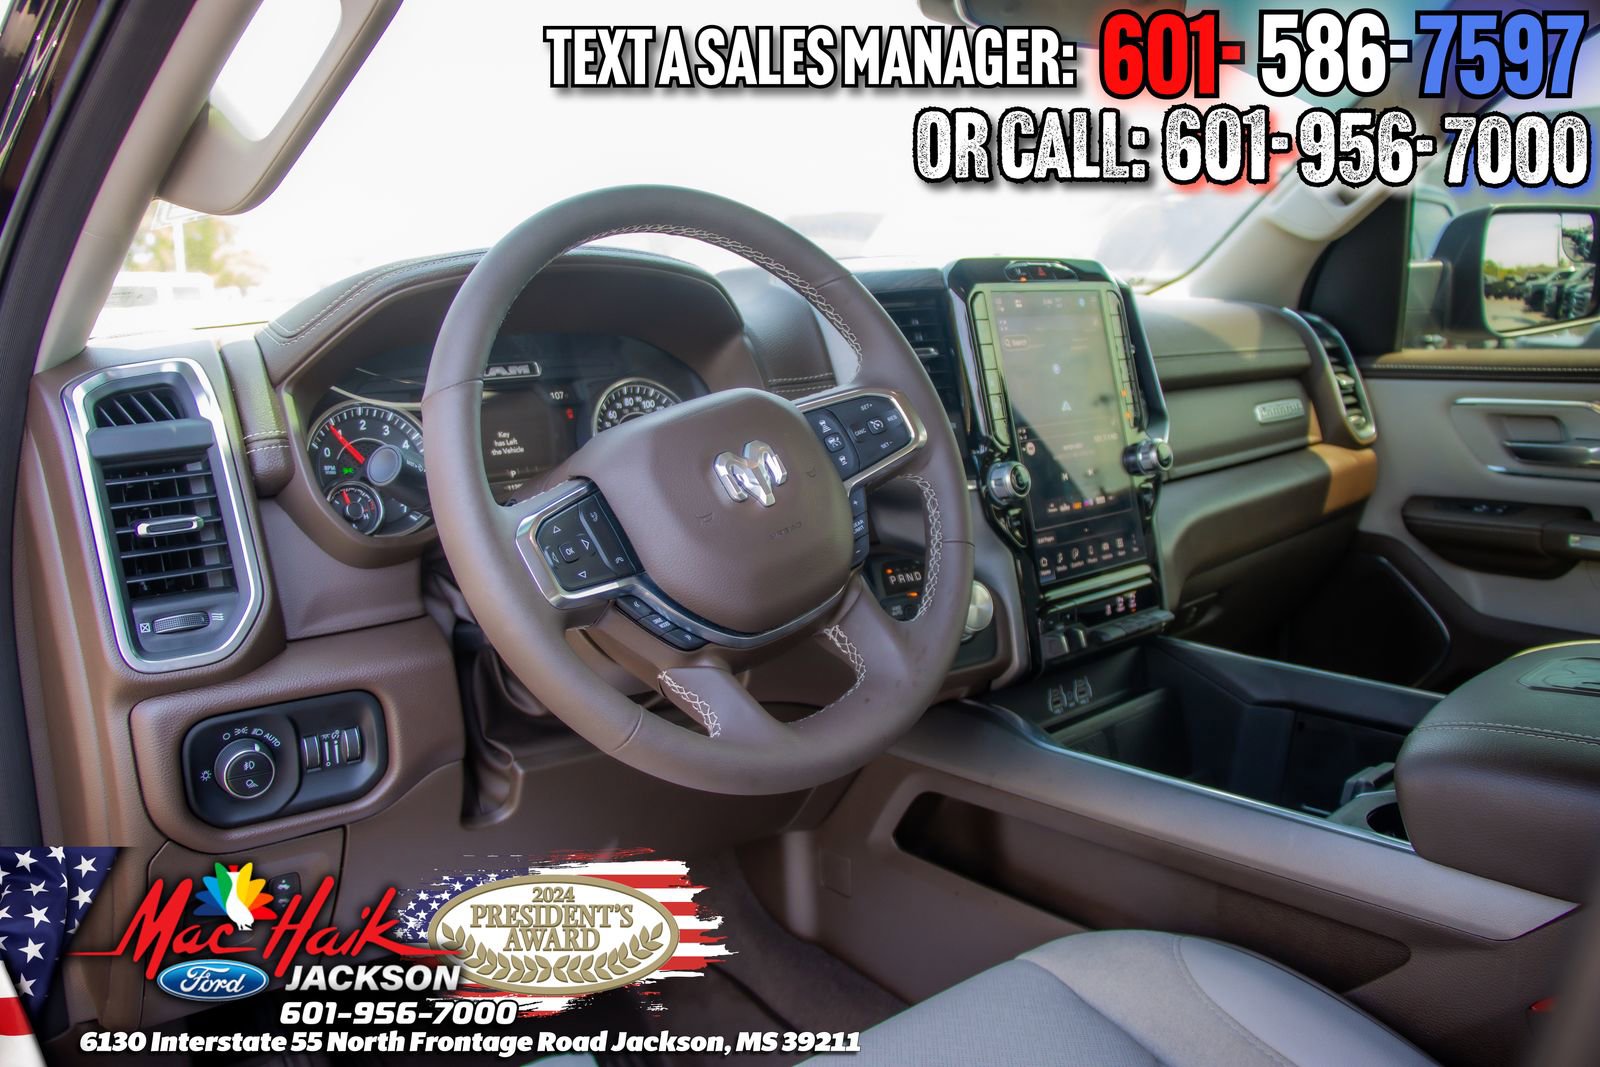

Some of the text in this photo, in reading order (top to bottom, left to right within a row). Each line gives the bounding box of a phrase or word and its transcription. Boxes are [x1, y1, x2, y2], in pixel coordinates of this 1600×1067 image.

[642, 399, 655, 408] 100
[360, 420, 366, 430] 2
[383, 425, 390, 436] 3
[402, 440, 409, 449] 4
[263, 732, 281, 748] AUTO
